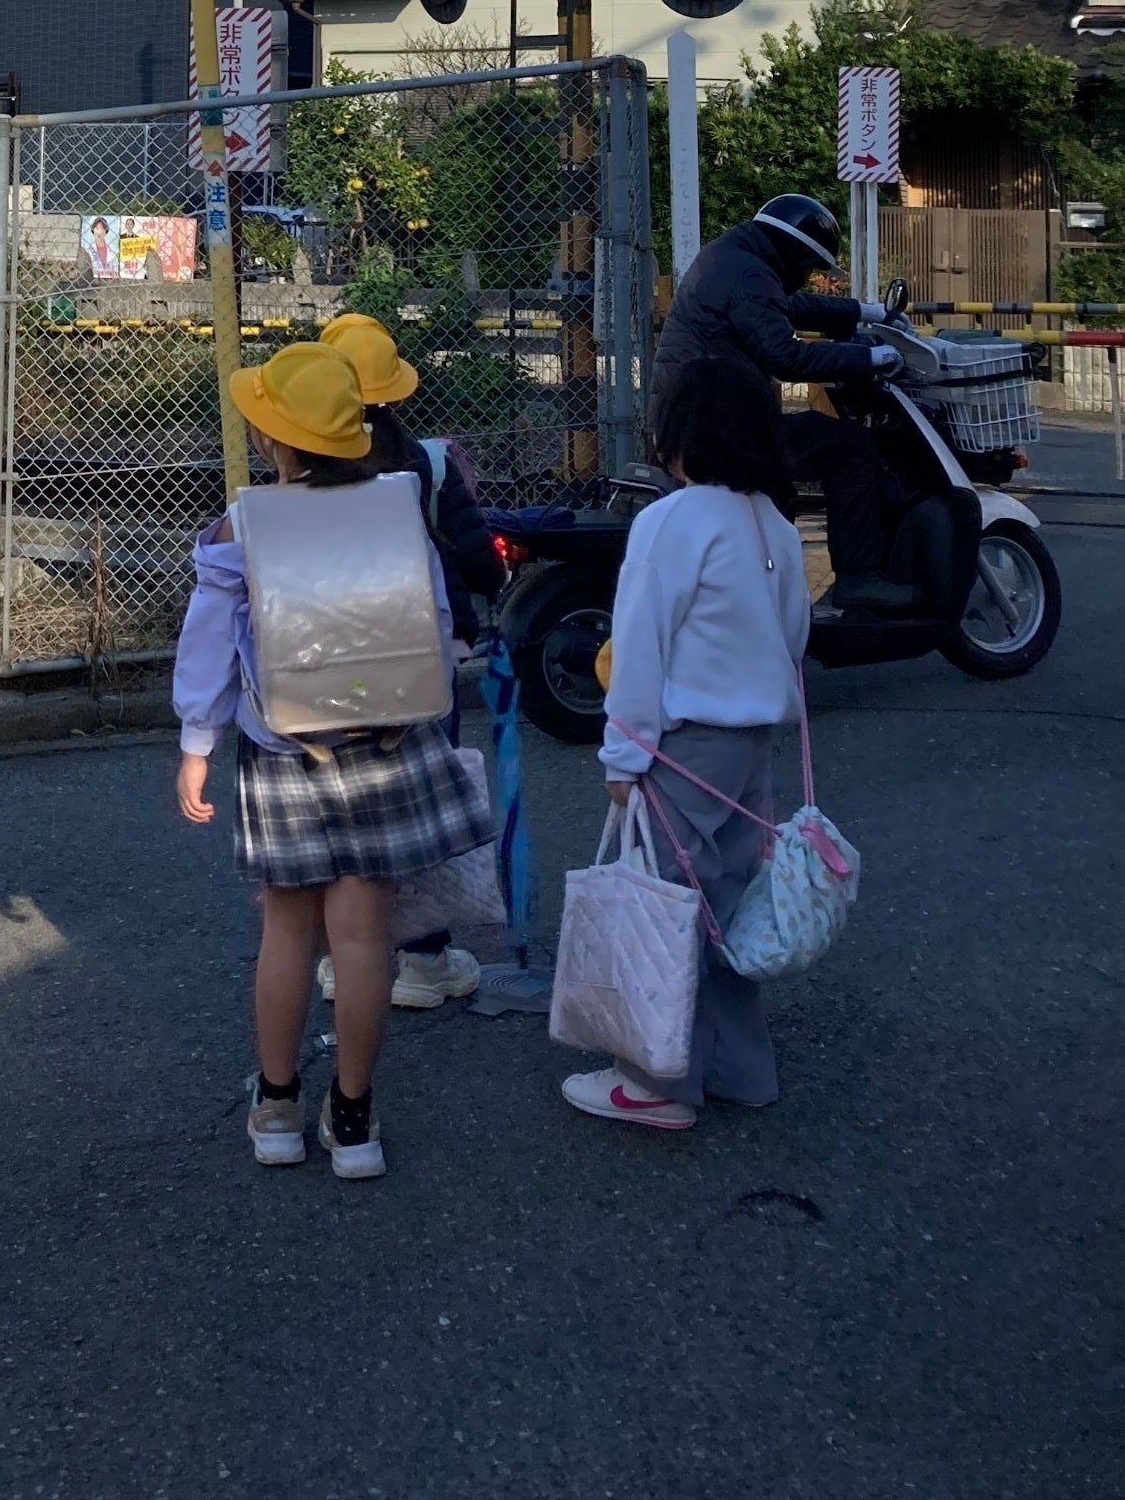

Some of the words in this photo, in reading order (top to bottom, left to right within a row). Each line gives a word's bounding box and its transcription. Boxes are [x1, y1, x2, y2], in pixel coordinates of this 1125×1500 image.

[860, 77, 878, 152] 非常ボタン
[207, 182, 227, 230] 注意
